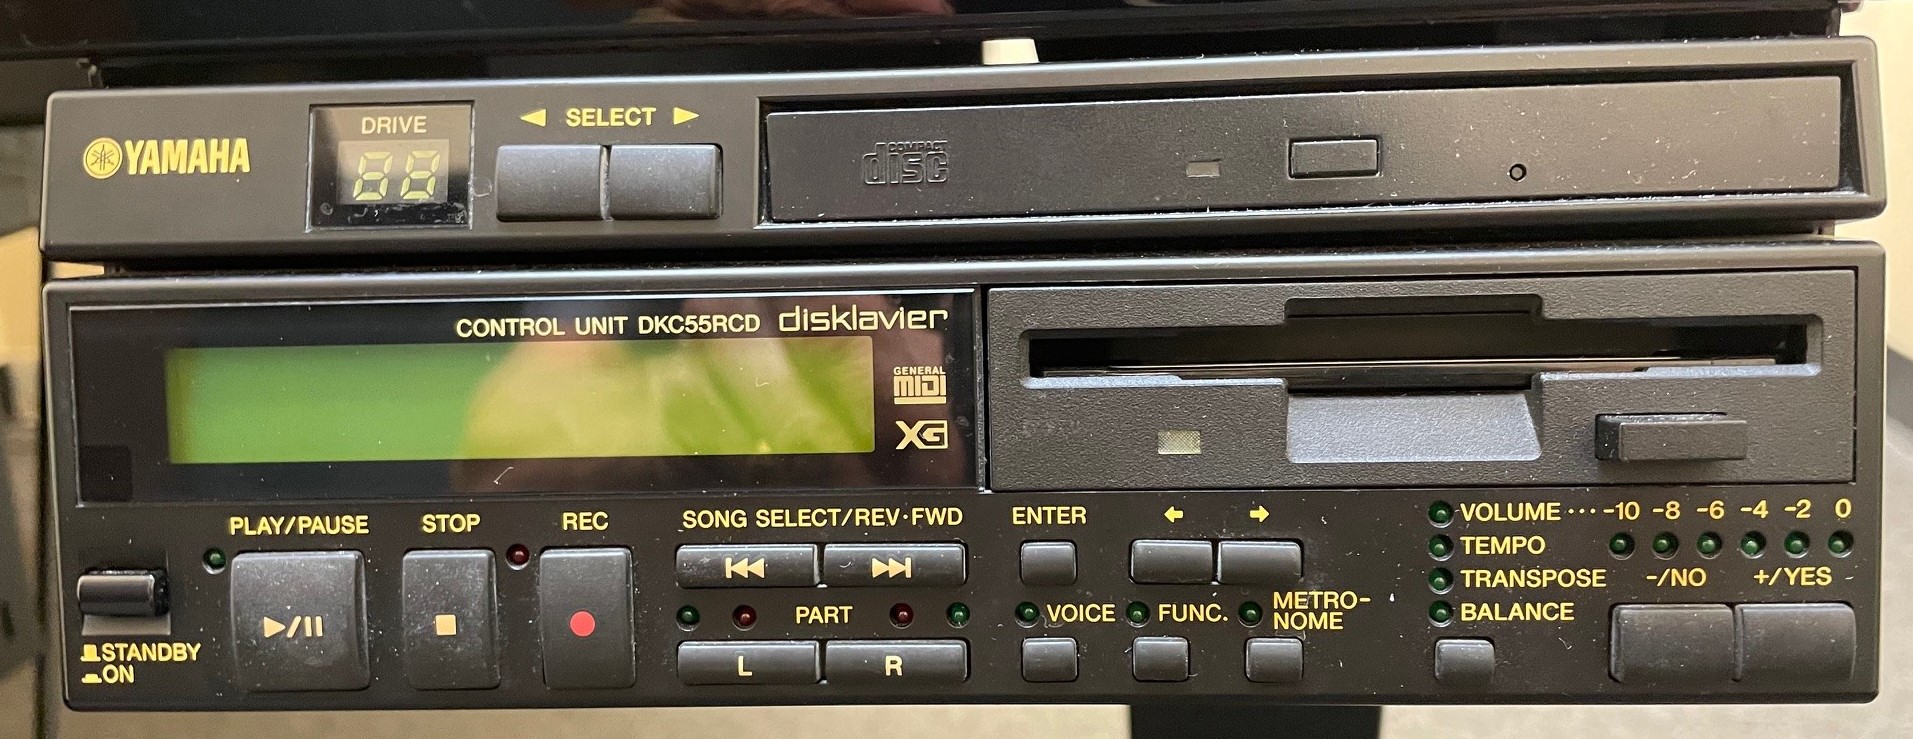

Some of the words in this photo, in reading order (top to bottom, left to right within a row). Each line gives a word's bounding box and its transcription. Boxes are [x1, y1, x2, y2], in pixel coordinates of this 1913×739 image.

[361, 115, 427, 135] DRIVE
[566, 106, 657, 128] SELECT
[888, 140, 948, 152] COMPACT
[124, 138, 250, 175] YAMAHA
[353, 150, 441, 201] 88
[456, 318, 566, 338] CONTROL
[575, 316, 628, 336] UNIT
[638, 313, 761, 335] DKC55RCD
[778, 304, 948, 332] disklavier
[893, 365, 946, 376] GENERAL
[895, 420, 949, 450] XG
[1012, 506, 1087, 525] ENTER
[1460, 502, 1561, 521] VOLUME
[1602, 501, 1640, 520] -10
[1652, 500, 1681, 519] -8
[1696, 500, 1725, 519] -6
[1740, 499, 1769, 518] -4
[1784, 499, 1812, 518] -2
[229, 514, 370, 536] PLAY/PAUSE
[422, 513, 481, 534] STOP
[562, 511, 609, 531] REC
[682, 509, 748, 529] SONG
[1460, 535, 1546, 555] TEMPO
[1460, 568, 1607, 588] TRANSPOSE
[1645, 567, 1707, 587] -/NO
[1753, 566, 1833, 586] +/YES
[1273, 590, 1371, 610] METRO-
[795, 605, 854, 625] PART
[1046, 603, 1116, 623] VOICE
[1158, 603, 1229, 623] FUNC.
[1273, 611, 1344, 631] NOME
[1460, 602, 1575, 622] BALANCE
[101, 642, 202, 663] STANDBY
[102, 664, 135, 684] ON
[737, 655, 753, 677] L
[884, 655, 903, 677] R
